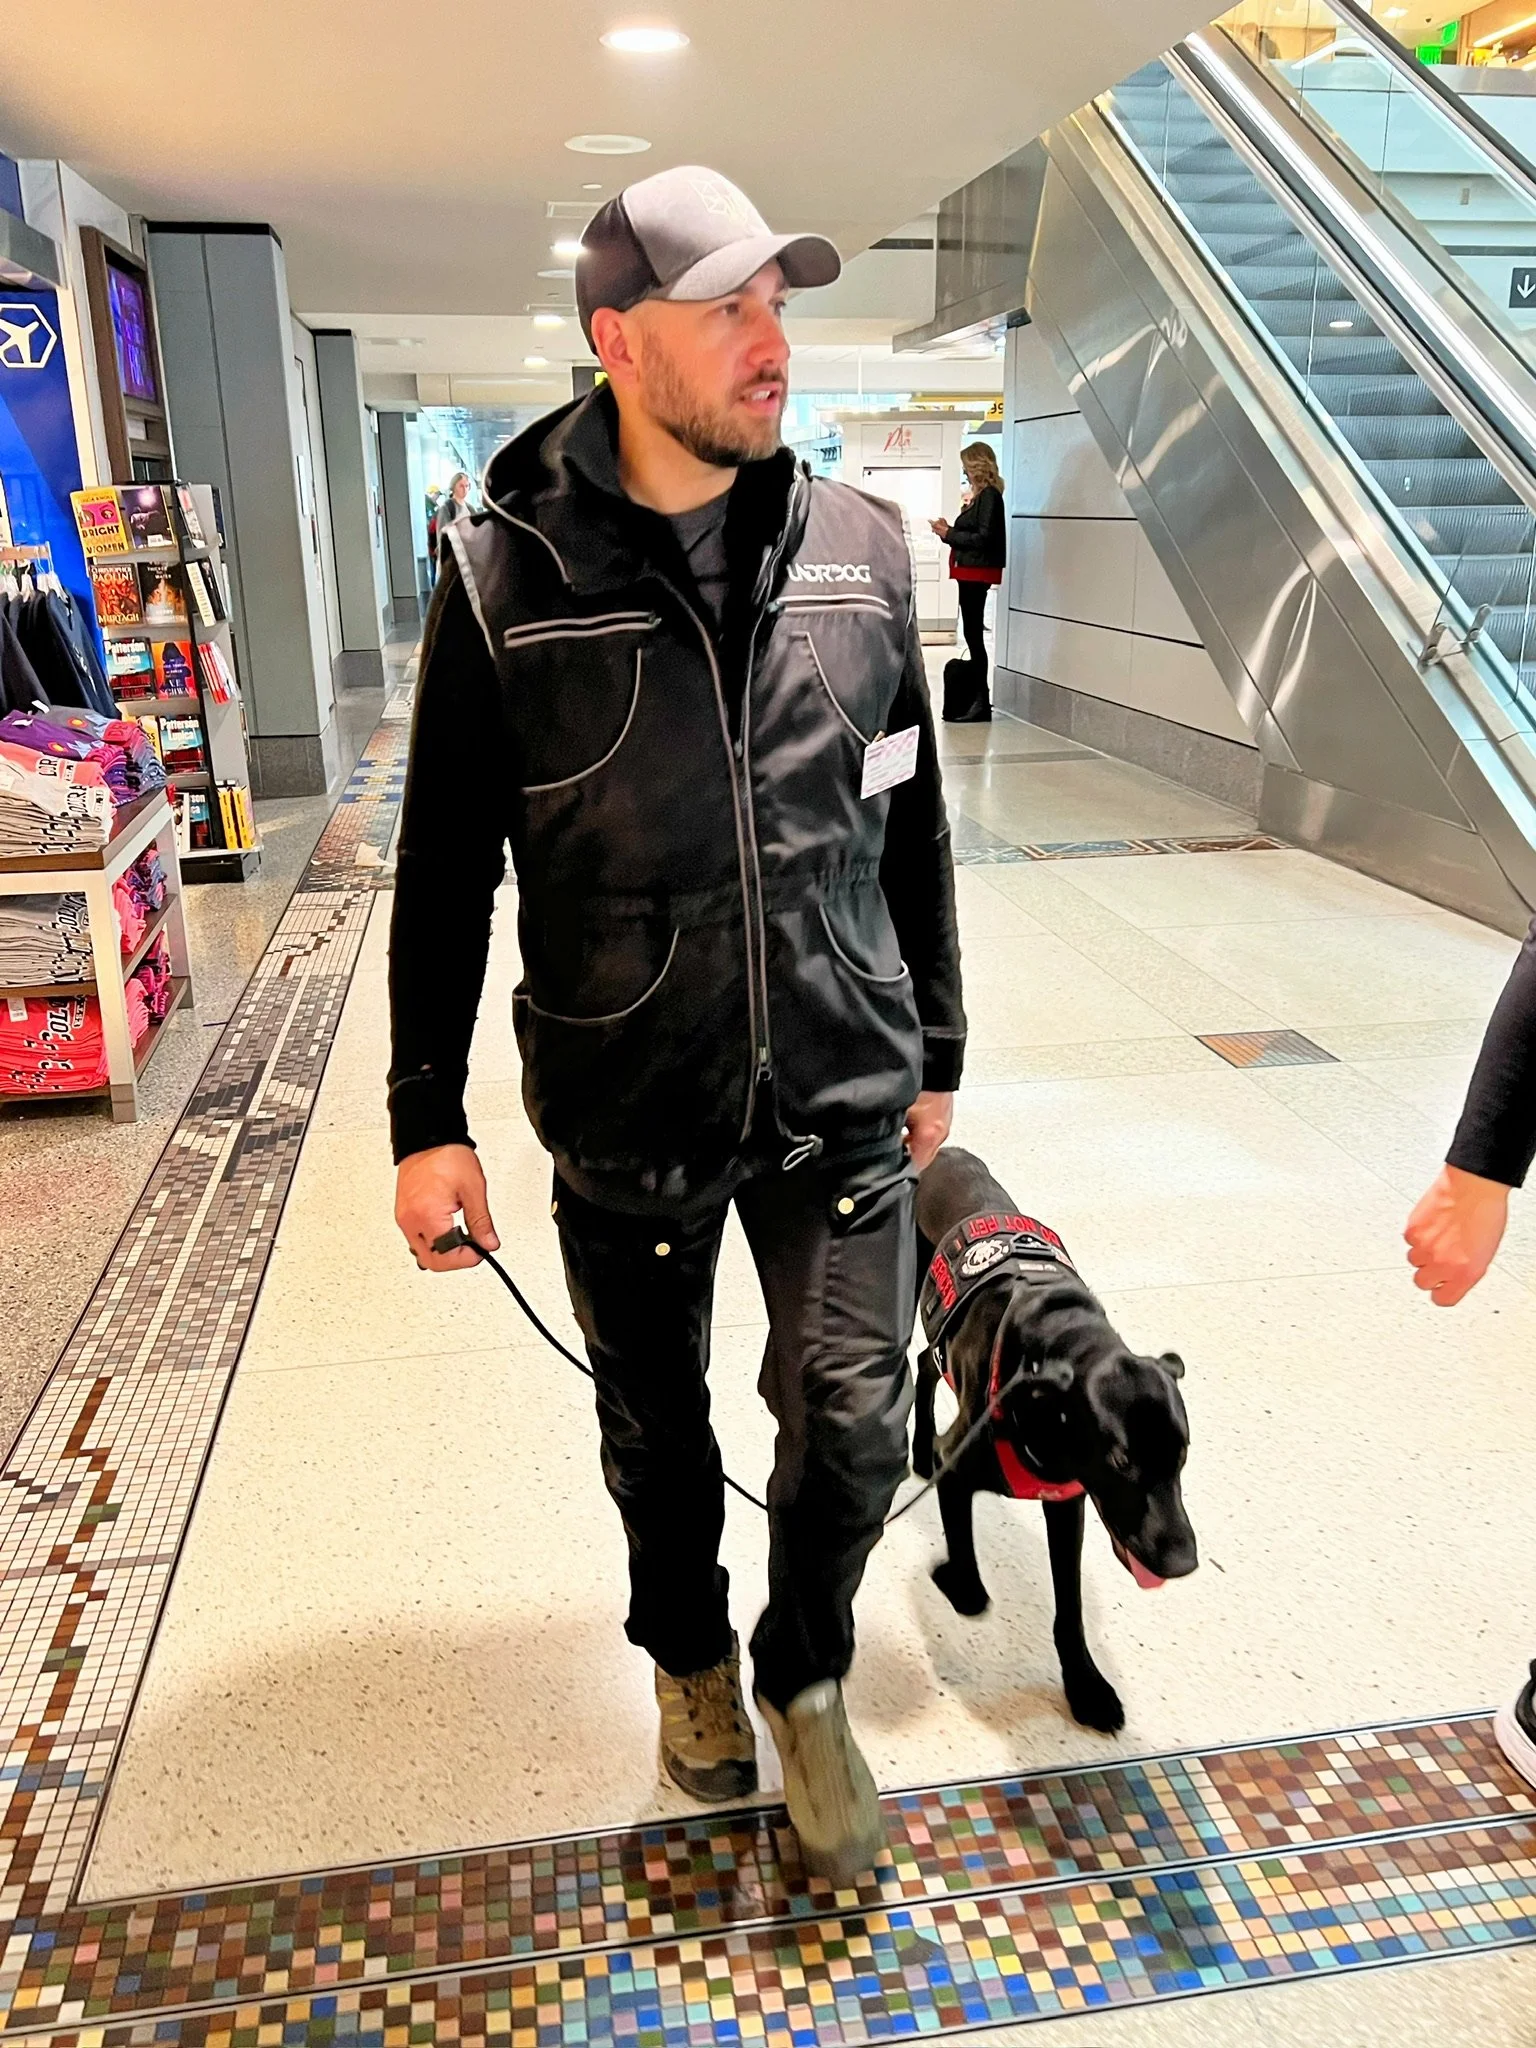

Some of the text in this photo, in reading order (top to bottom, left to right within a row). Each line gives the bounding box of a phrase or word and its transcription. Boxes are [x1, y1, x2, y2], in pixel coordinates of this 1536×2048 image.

[82, 525, 120, 538] BRIGHT
[87, 543, 125, 554] WOMEN
[92, 571, 133, 581] PAOLINI
[98, 613, 140, 624] MURTAGH
[104, 640, 146, 655] Patterson
[112, 652, 141, 665] Lupica
[160, 717, 200, 731] Patterson
[168, 728, 194, 741] Lupica
[969, 1214, 1000, 1238] PET
[1004, 1214, 1037, 1233] NOT
